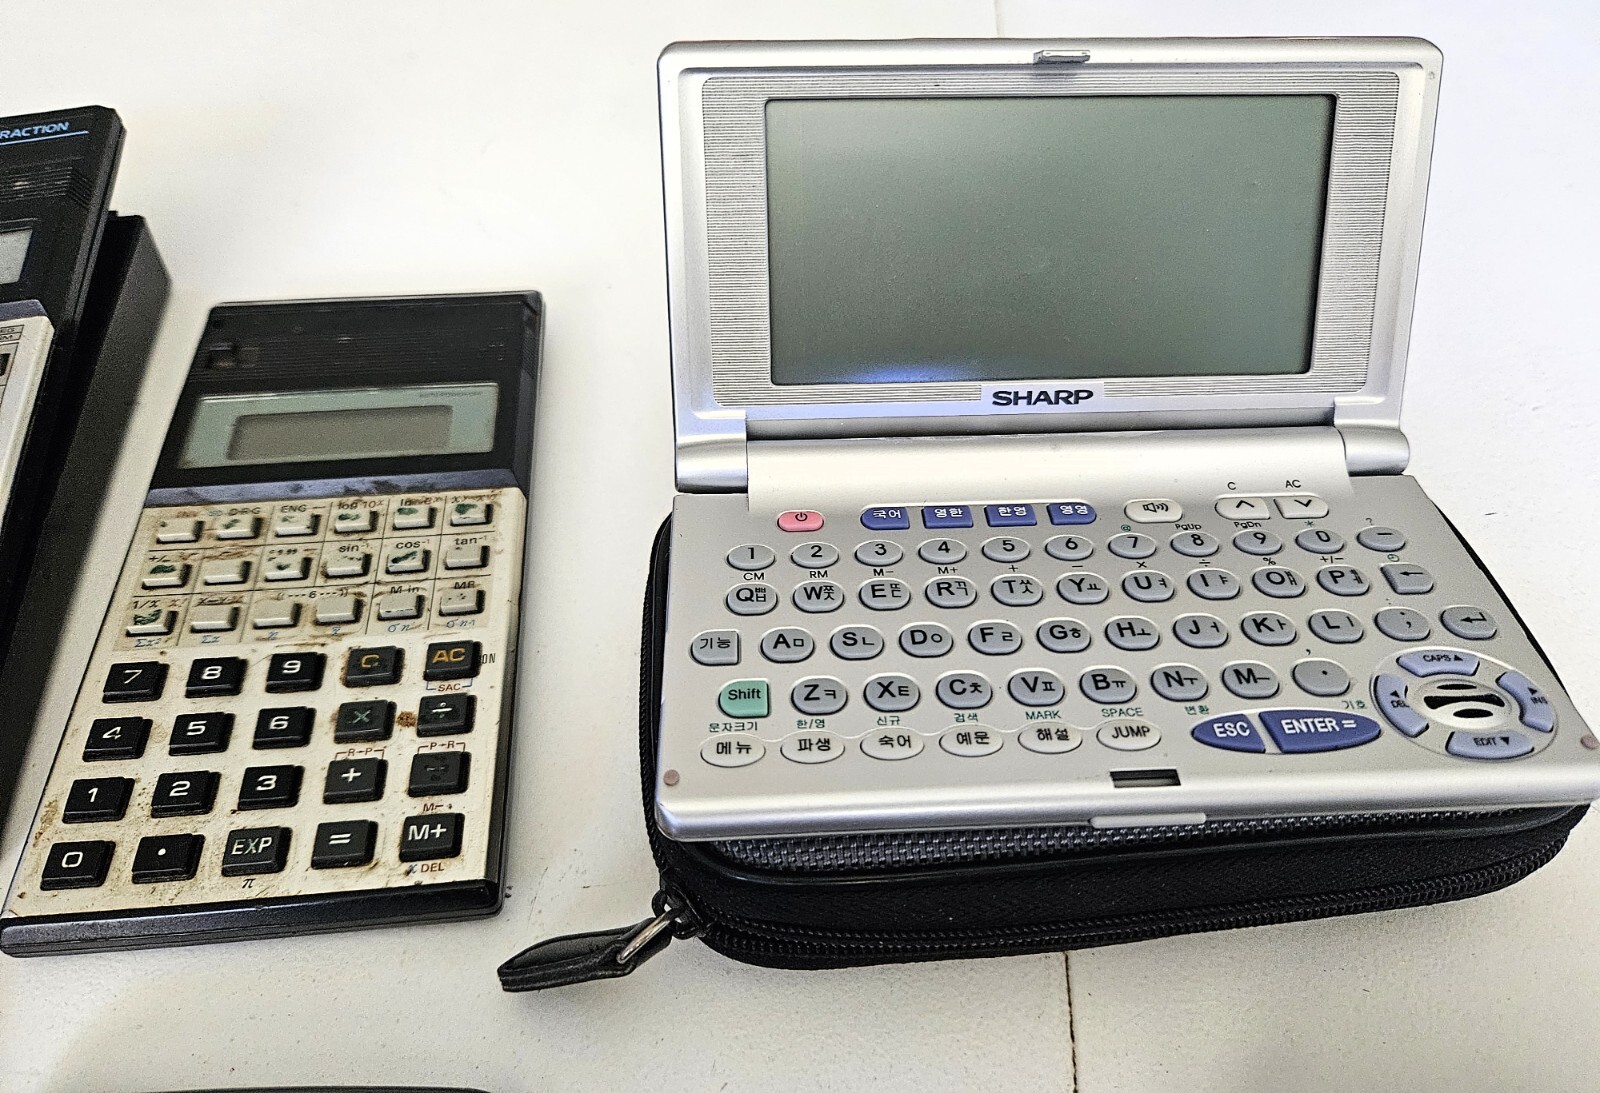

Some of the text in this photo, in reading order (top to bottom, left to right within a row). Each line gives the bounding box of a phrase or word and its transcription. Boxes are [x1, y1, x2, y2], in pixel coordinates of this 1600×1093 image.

[0, 121, 69, 139] RACTION
[992, 389, 1094, 406] SHARP
[1227, 481, 1236, 490] C
[1285, 479, 1301, 489] AC
[873, 509, 901, 519] 국어
[934, 508, 963, 517] 영한
[998, 506, 1027, 517] 한영
[1120, 524, 1131, 532] @
[1175, 522, 1202, 531] PgUp
[1234, 520, 1262, 529] PgDn
[1365, 517, 1373, 526] ?
[1065, 537, 1079, 550] 6
[1127, 536, 1138, 549] 7
[1192, 533, 1205, 546] 8
[1253, 532, 1267, 545] 9
[1315, 530, 1330, 543] 0
[810, 545, 823, 558] 2
[874, 543, 887, 556] 3
[937, 541, 951, 554] 4
[1002, 539, 1016, 552] 5
[748, 547, 756, 560] 1
[1263, 557, 1276, 566] %
[743, 572, 765, 581] CM
[809, 570, 828, 579] RM
[937, 566, 959, 575] M+
[1328, 570, 1345, 584] P
[1068, 578, 1085, 592] Y
[1133, 576, 1152, 590] U
[1199, 573, 1209, 587] I
[1266, 571, 1286, 585] O
[803, 586, 824, 600] W
[871, 583, 887, 598] E
[936, 582, 954, 596] R
[1002, 580, 1017, 594] T
[736, 588, 755, 602] Q
[1189, 620, 1200, 635] J
[1252, 617, 1275, 633] K
[1321, 615, 1340, 629] L
[910, 629, 928, 645] D
[980, 627, 994, 643] F
[1050, 624, 1068, 640] G
[1116, 622, 1136, 638] H
[700, 637, 731, 650] 기능
[773, 633, 791, 649] A
[842, 631, 858, 647] S
[361, 654, 380, 668] C
[432, 648, 466, 664] AC
[1422, 654, 1452, 663] CAPS
[202, 664, 223, 681] 8
[281, 660, 302, 675] 9
[123, 669, 143, 685] 7
[1091, 673, 1111, 691] B
[1162, 671, 1185, 688] N
[1233, 667, 1258, 685] M
[437, 683, 461, 692] SAC
[876, 680, 896, 699] X
[949, 679, 968, 695] C
[1021, 676, 1040, 693] V
[728, 688, 761, 701] Shift
[804, 684, 820, 701] Z
[1390, 700, 1410, 709] DEL
[1025, 710, 1062, 721] MARK
[1101, 707, 1144, 718] SPACE
[268, 714, 289, 731] 6
[876, 716, 900, 726] 신규
[1281, 717, 1340, 735] ENTER
[102, 724, 122, 741] 4
[186, 720, 207, 737] 5
[1036, 727, 1069, 742] 해설
[1111, 725, 1151, 739] JUMP
[1213, 721, 1250, 738] ESC
[797, 738, 831, 753] 파생
[878, 734, 911, 749] 숙어
[956, 731, 991, 746] 예문
[1473, 737, 1497, 746] EDIT
[716, 741, 752, 755] 메뉴
[169, 780, 191, 798] 2
[256, 774, 277, 792] 3
[87, 787, 98, 803] 1
[408, 824, 447, 841] M+
[230, 836, 273, 855] EXP
[420, 862, 445, 873] DEL
